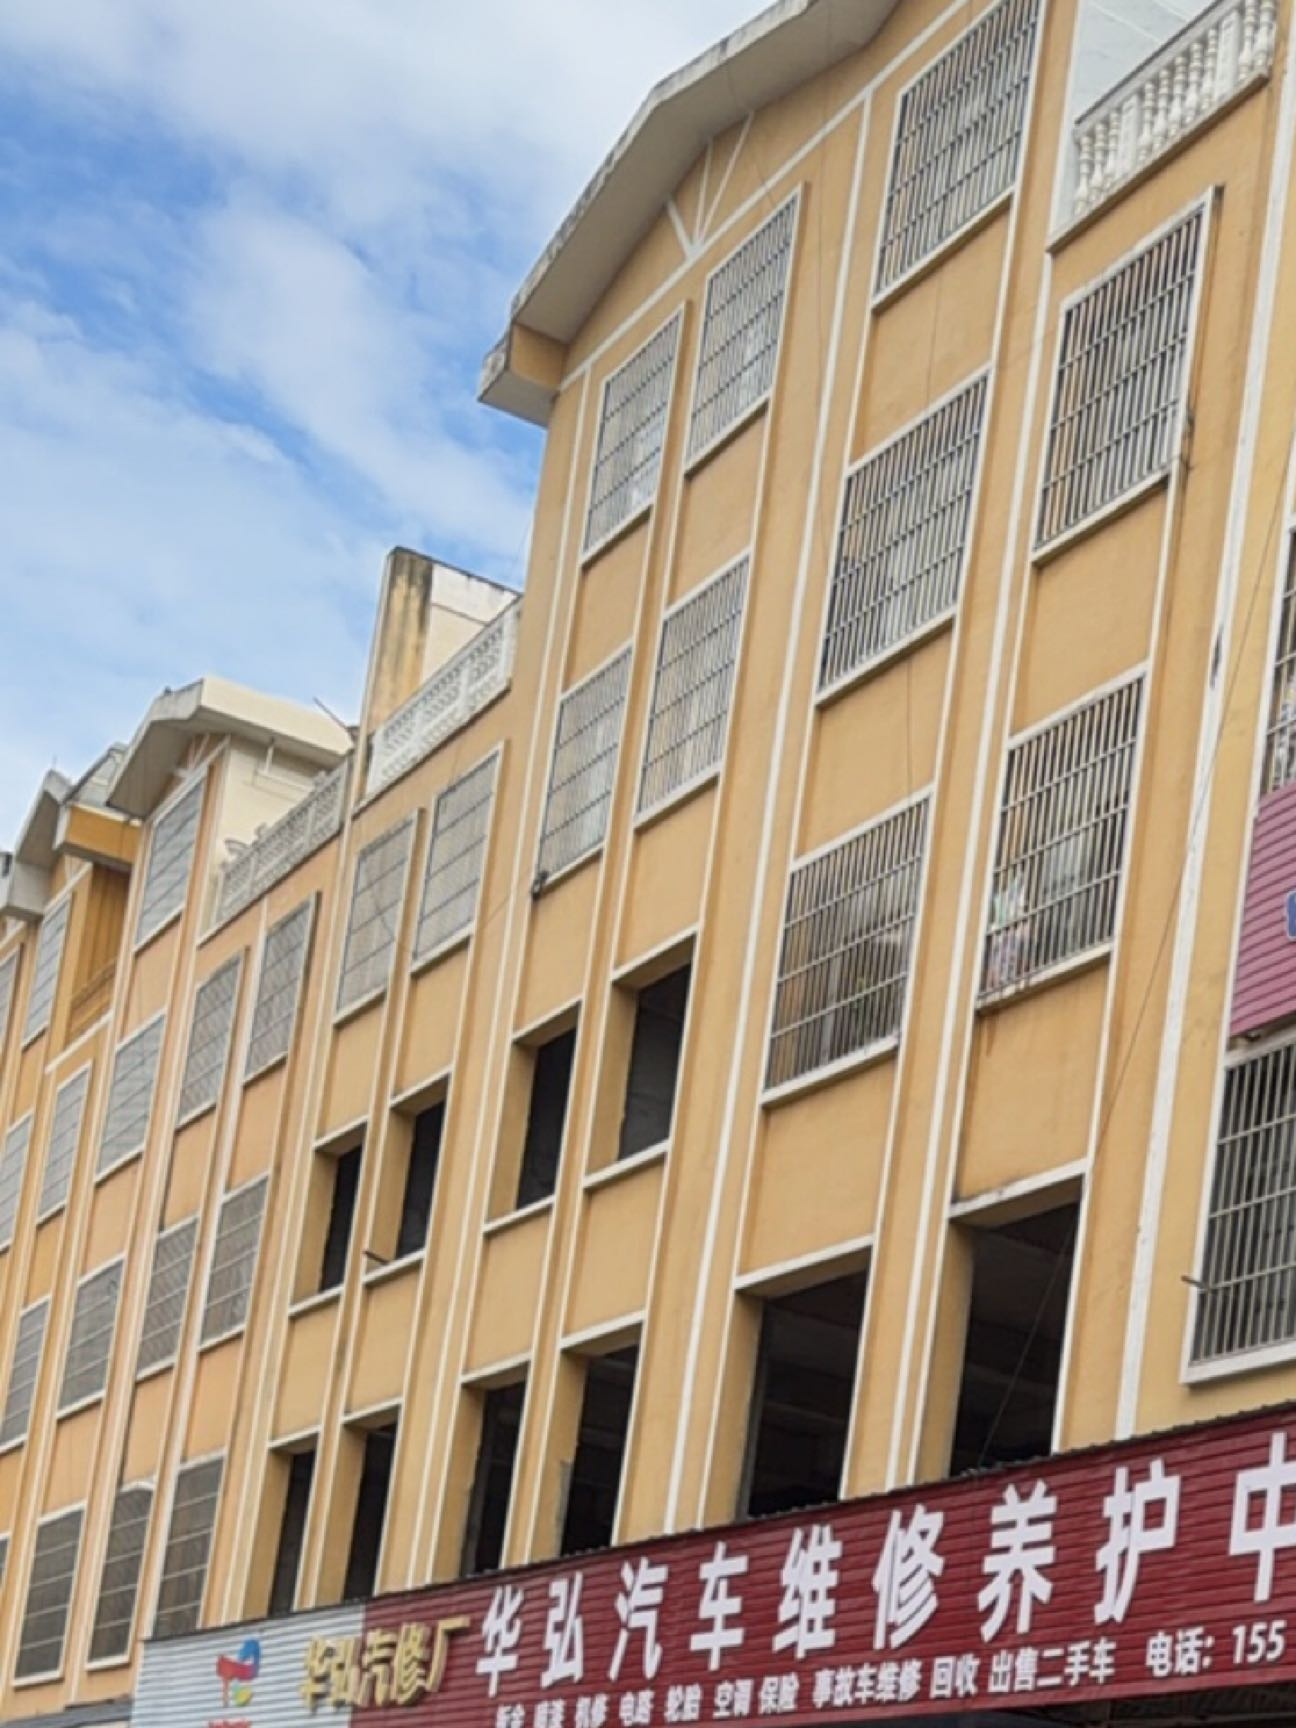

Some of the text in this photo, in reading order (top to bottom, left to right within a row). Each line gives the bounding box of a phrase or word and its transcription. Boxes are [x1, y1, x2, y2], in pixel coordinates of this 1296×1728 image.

[299, 1615, 471, 1716] 华弘汽修厂
[712, 1677, 755, 1720] 空调
[757, 1672, 801, 1716] 保险
[812, 1657, 923, 1709] 事故车维修
[929, 1652, 981, 1700] 回收
[987, 1636, 1118, 1694] 出售二手车
[1231, 1619, 1287, 1665] 155
